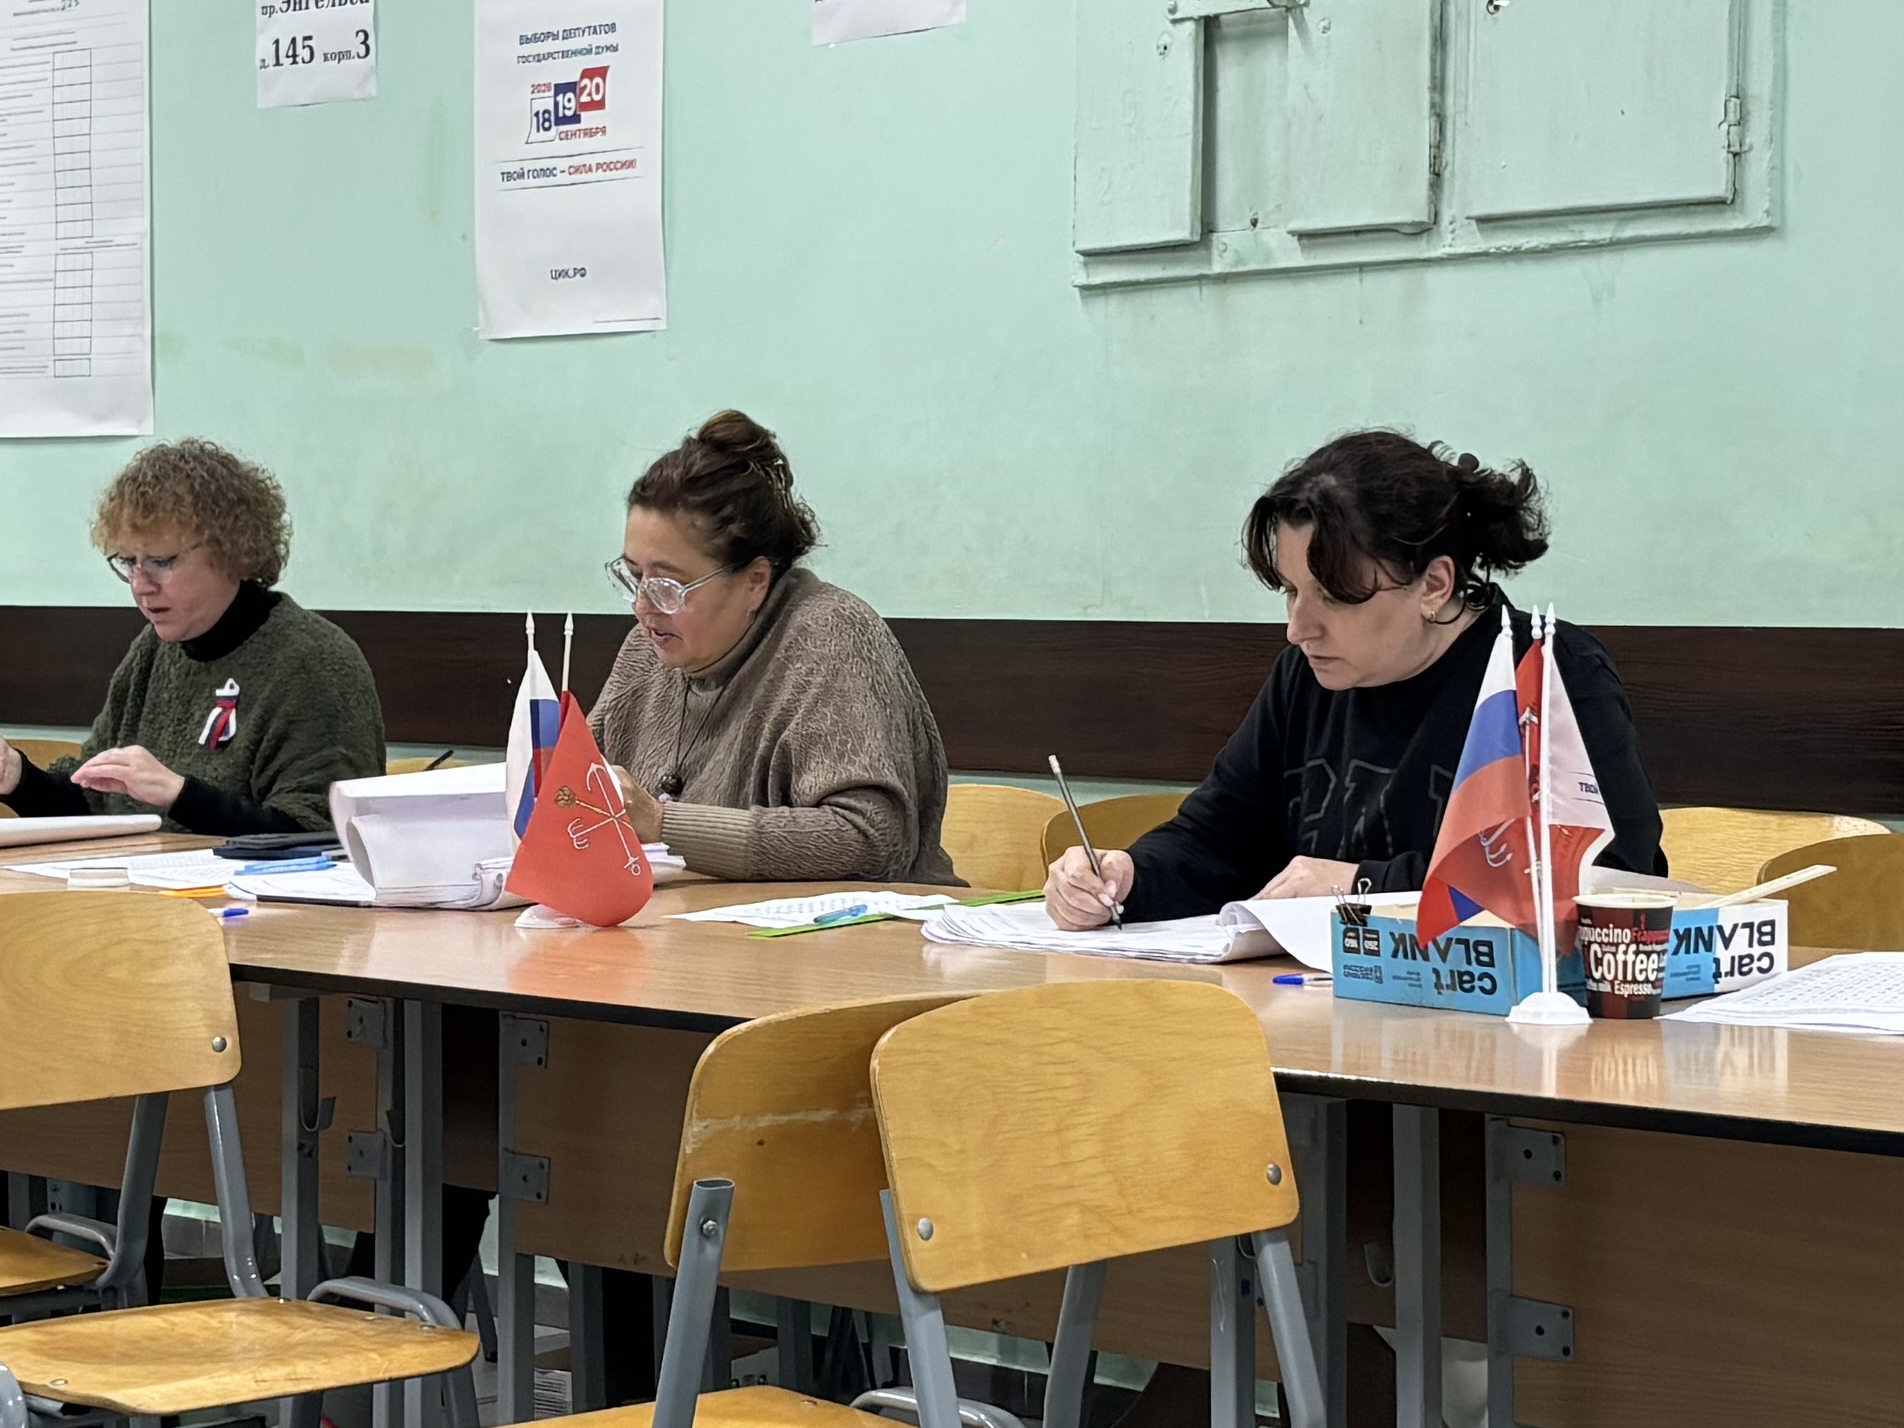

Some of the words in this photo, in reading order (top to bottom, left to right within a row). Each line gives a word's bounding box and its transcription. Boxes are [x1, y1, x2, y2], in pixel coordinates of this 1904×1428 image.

[519, 30, 560, 46] ВЫБОРЫ
[561, 22, 617, 41] ДЕПУТАТОВ
[517, 44, 594, 64] ГОСУДАРСТВЕННОЙ
[579, 76, 605, 103] 20
[556, 91, 577, 118] 19
[533, 108, 552, 133] 18
[558, 126, 607, 141] СЕНТЯБРЯ
[500, 167, 525, 183] ТВОЙ
[526, 166, 558, 180] ГОЛОС
[567, 163, 594, 176] СИЛА
[1589, 942, 1659, 982] Coffee
[1713, 952, 1775, 984] cart
[1432, 966, 1497, 996] cart
